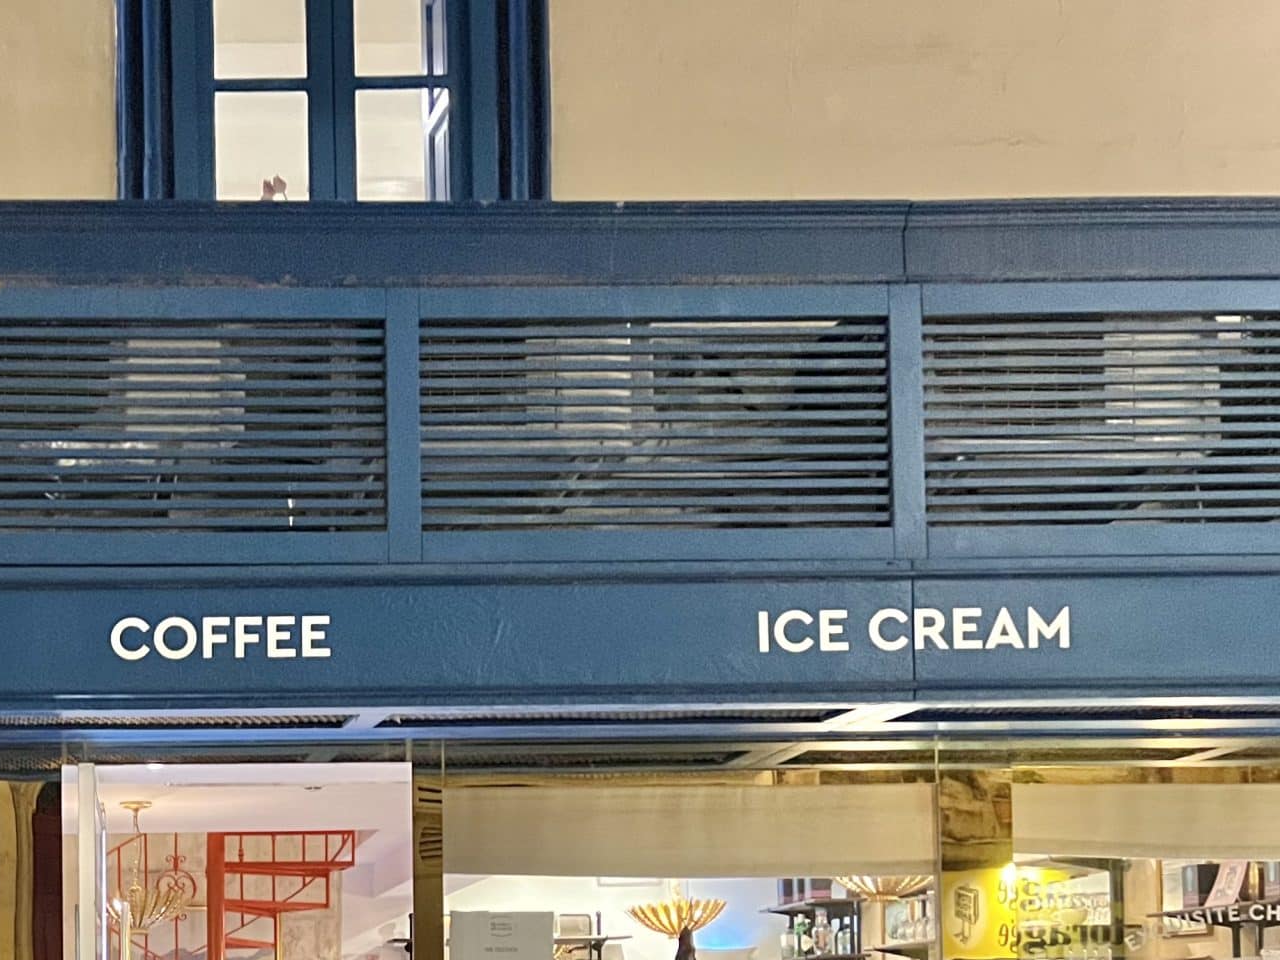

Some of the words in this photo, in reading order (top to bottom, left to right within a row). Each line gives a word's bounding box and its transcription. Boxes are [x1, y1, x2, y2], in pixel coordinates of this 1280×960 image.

[110, 615, 331, 660] COFFEE
[758, 609, 849, 653] ICE
[869, 606, 1070, 651] CREAM
